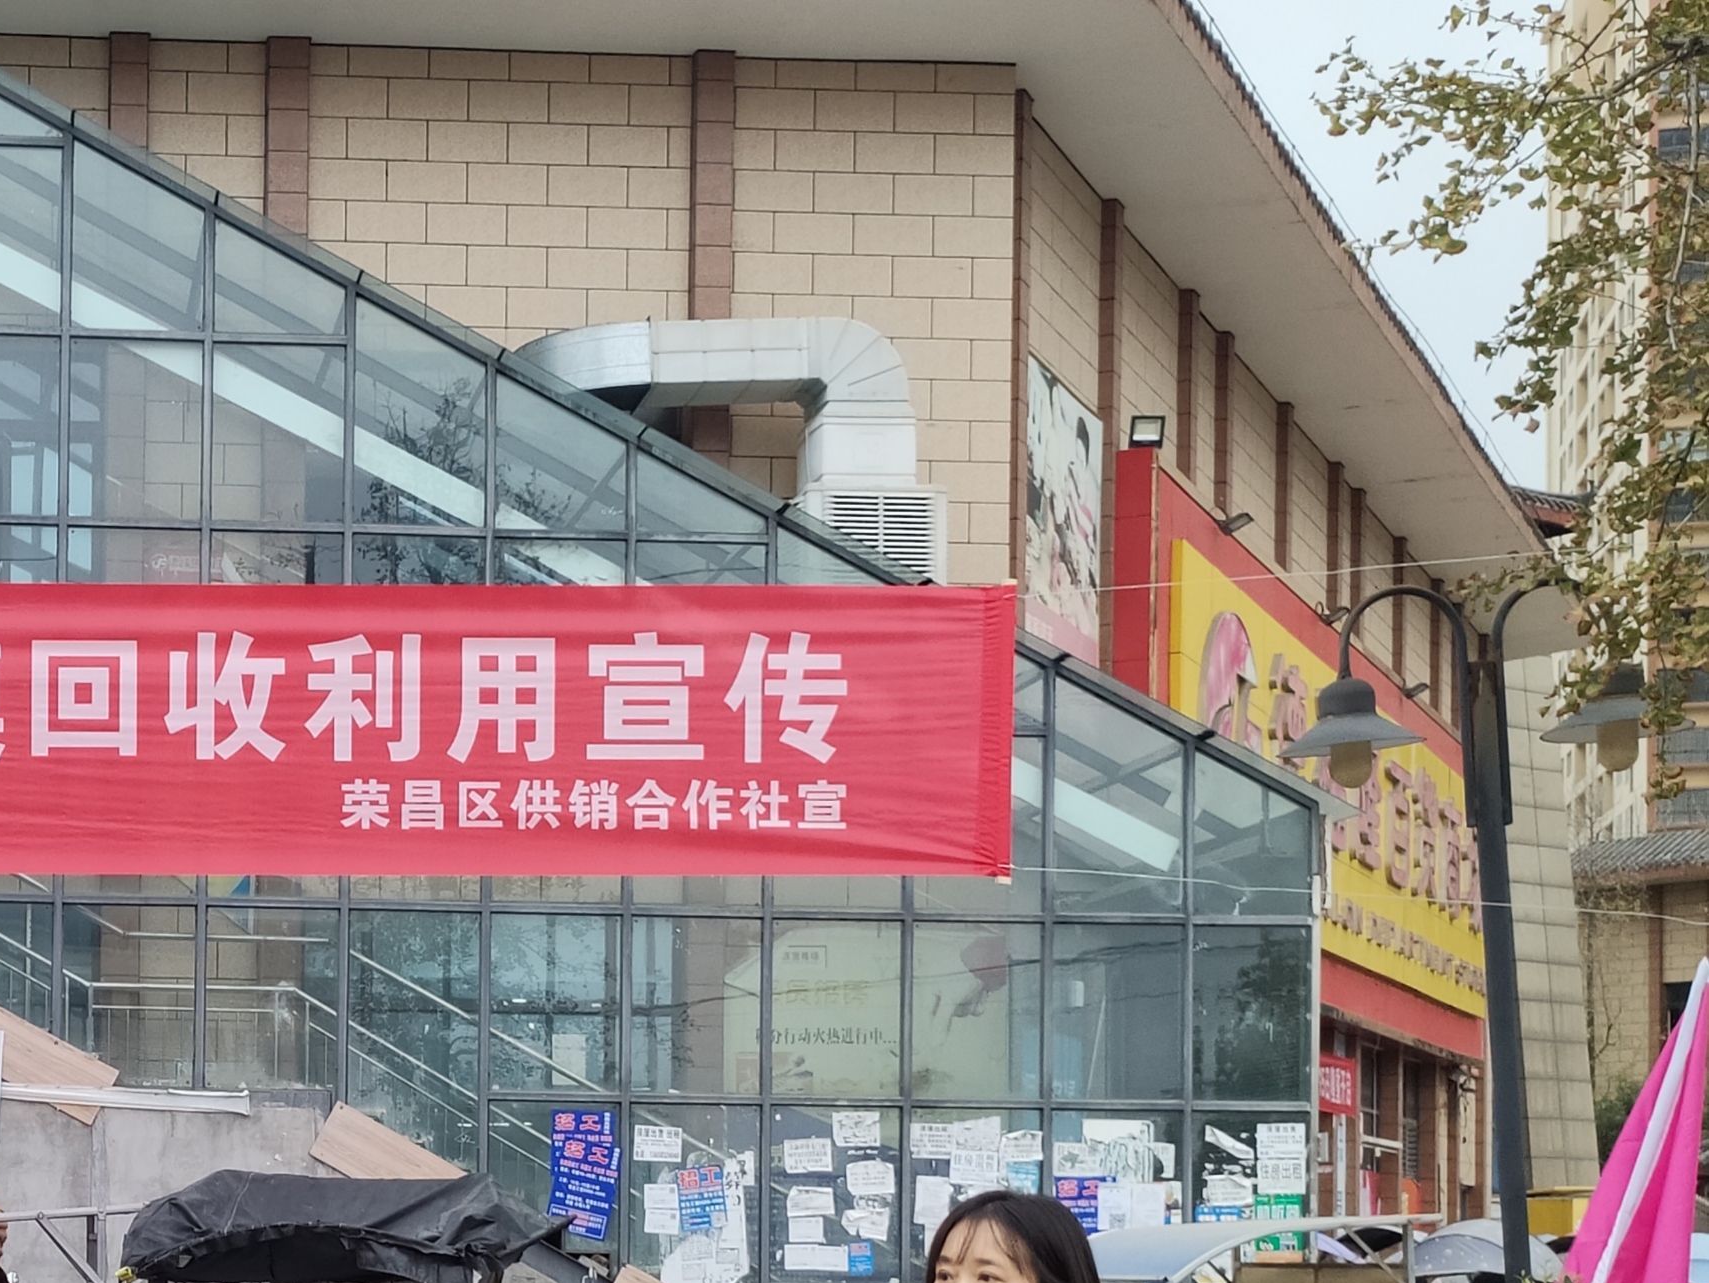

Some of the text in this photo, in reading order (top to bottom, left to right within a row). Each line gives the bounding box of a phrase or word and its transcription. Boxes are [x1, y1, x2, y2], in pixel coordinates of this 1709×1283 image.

[340, 778, 847, 832] 荣昌区供销合作社宣
